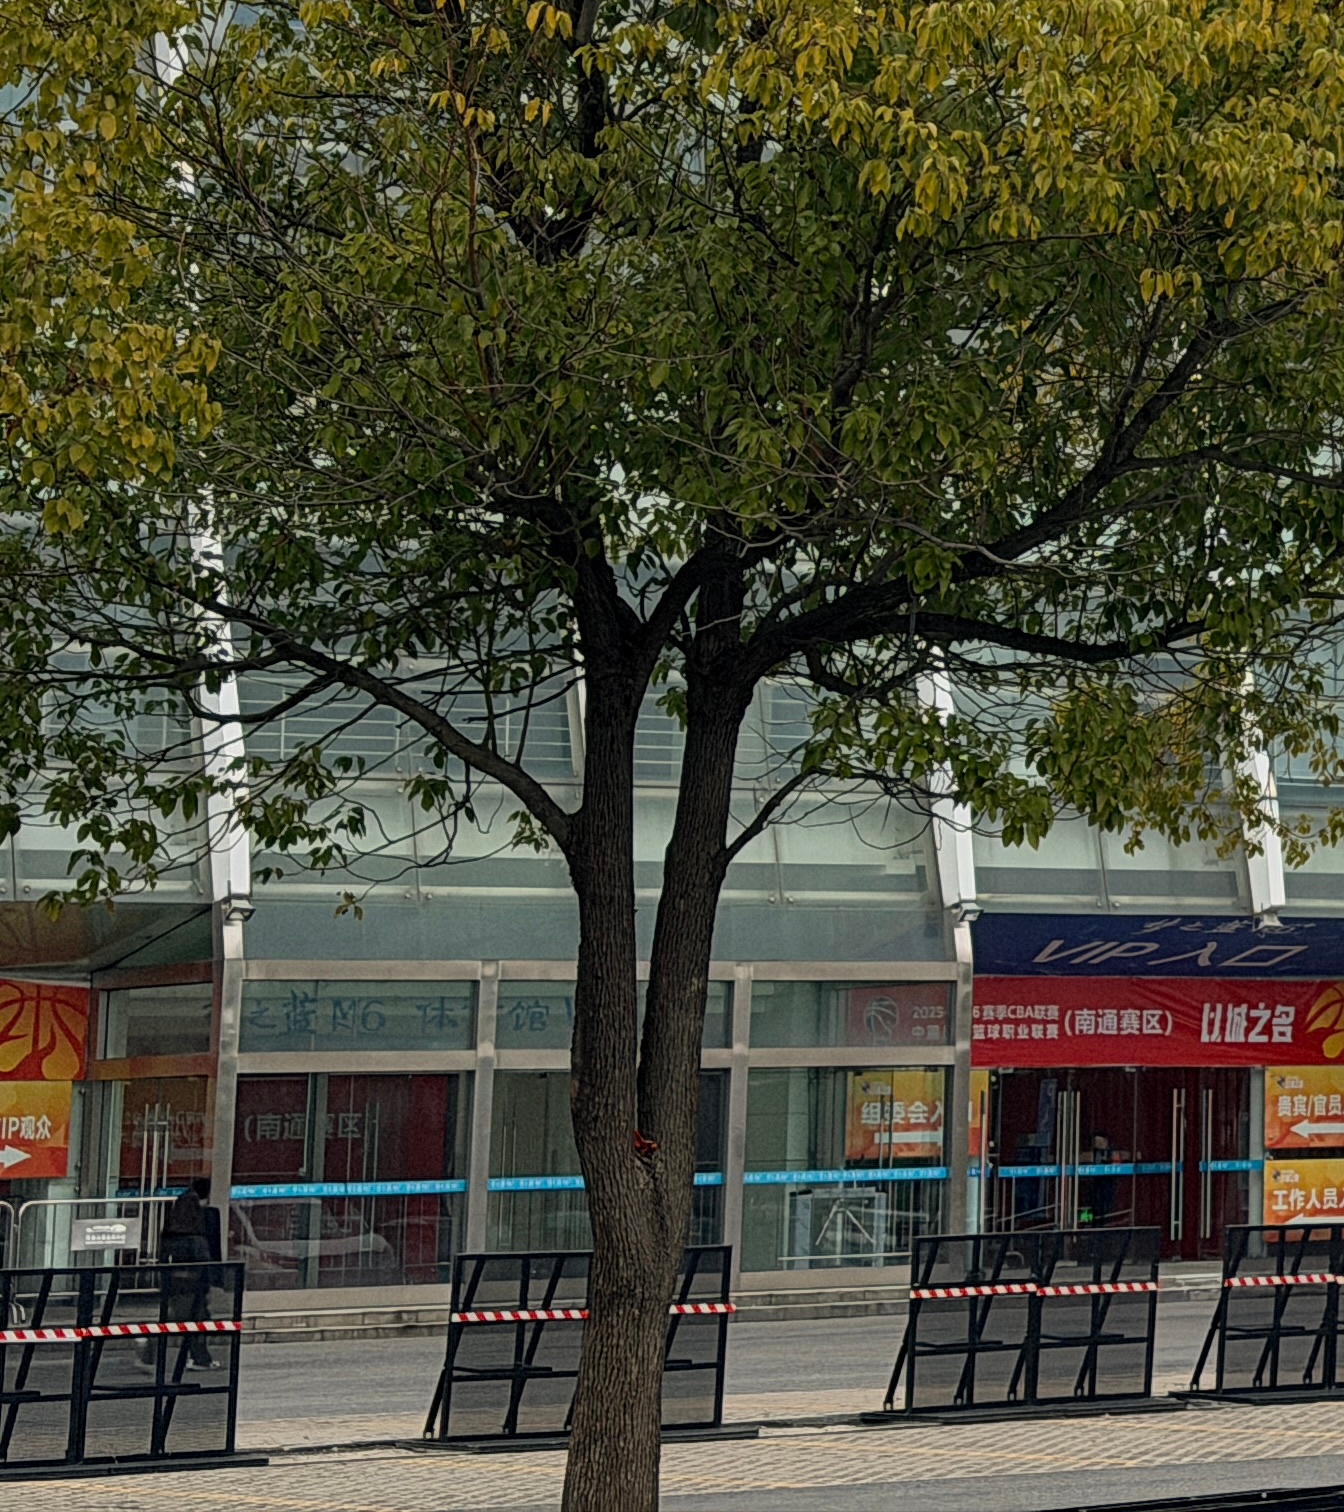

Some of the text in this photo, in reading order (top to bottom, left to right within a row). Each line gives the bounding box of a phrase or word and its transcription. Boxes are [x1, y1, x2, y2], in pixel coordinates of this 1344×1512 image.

[1033, 939, 1309, 967] VIP入口
[1064, 1008, 1173, 1037] (南通赛区)
[1200, 1002, 1296, 1043] 以城之名
[0, 1114, 52, 1140] IP观众
